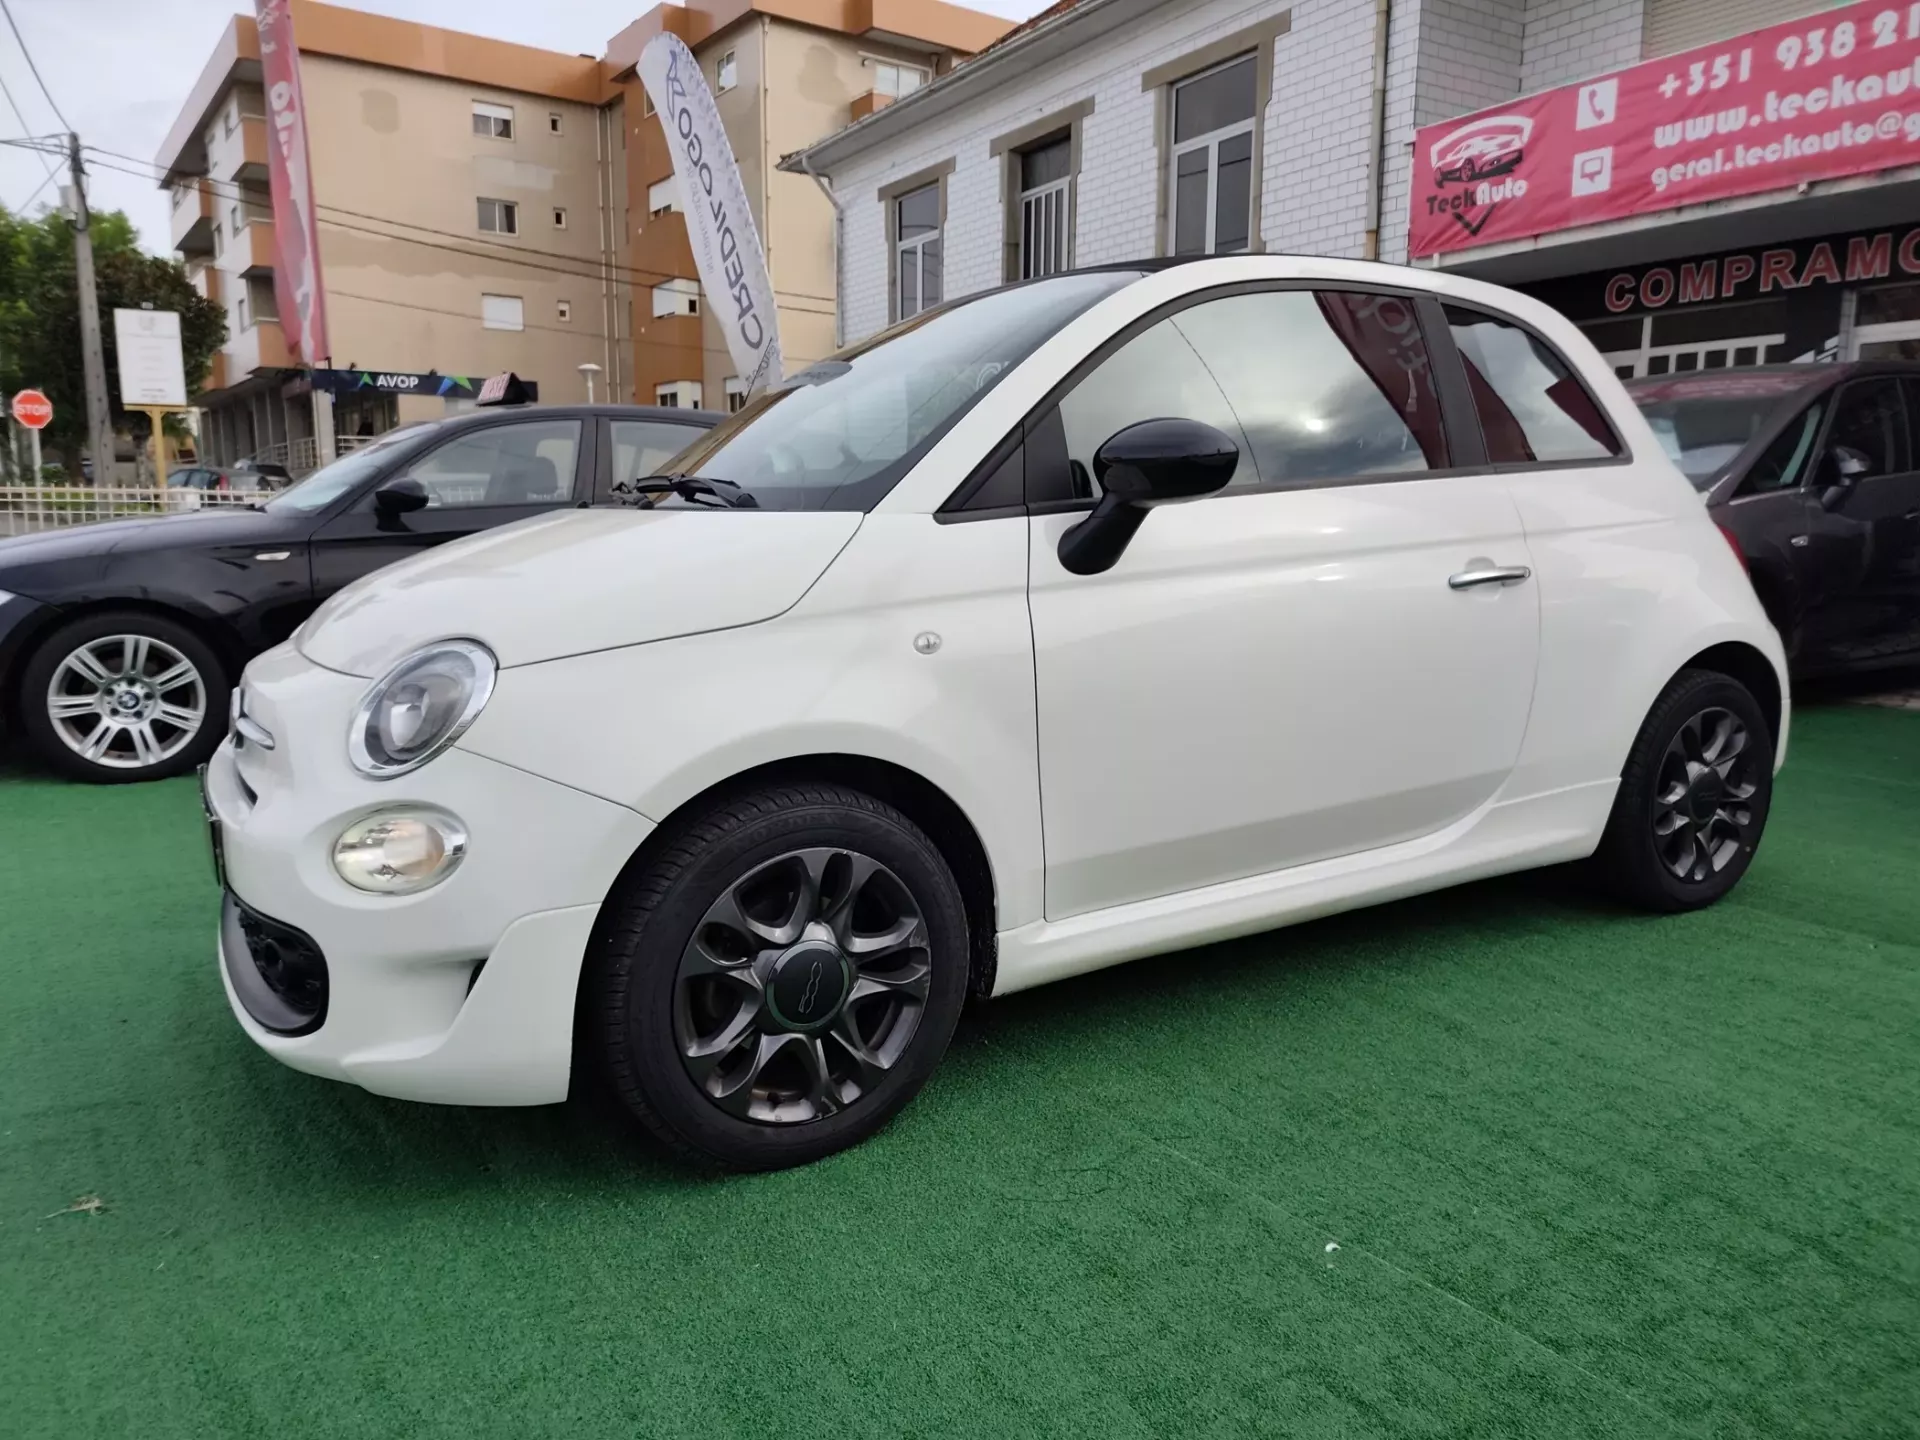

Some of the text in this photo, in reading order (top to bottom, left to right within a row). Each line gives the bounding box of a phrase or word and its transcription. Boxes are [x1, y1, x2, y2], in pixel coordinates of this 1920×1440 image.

[1657, 48, 1753, 99] +351
[1776, 21, 1856, 71] 938
[1426, 177, 1529, 215] TeckAuto
[376, 374, 420, 389] AVOP
[15, 404, 50, 416] STOP
